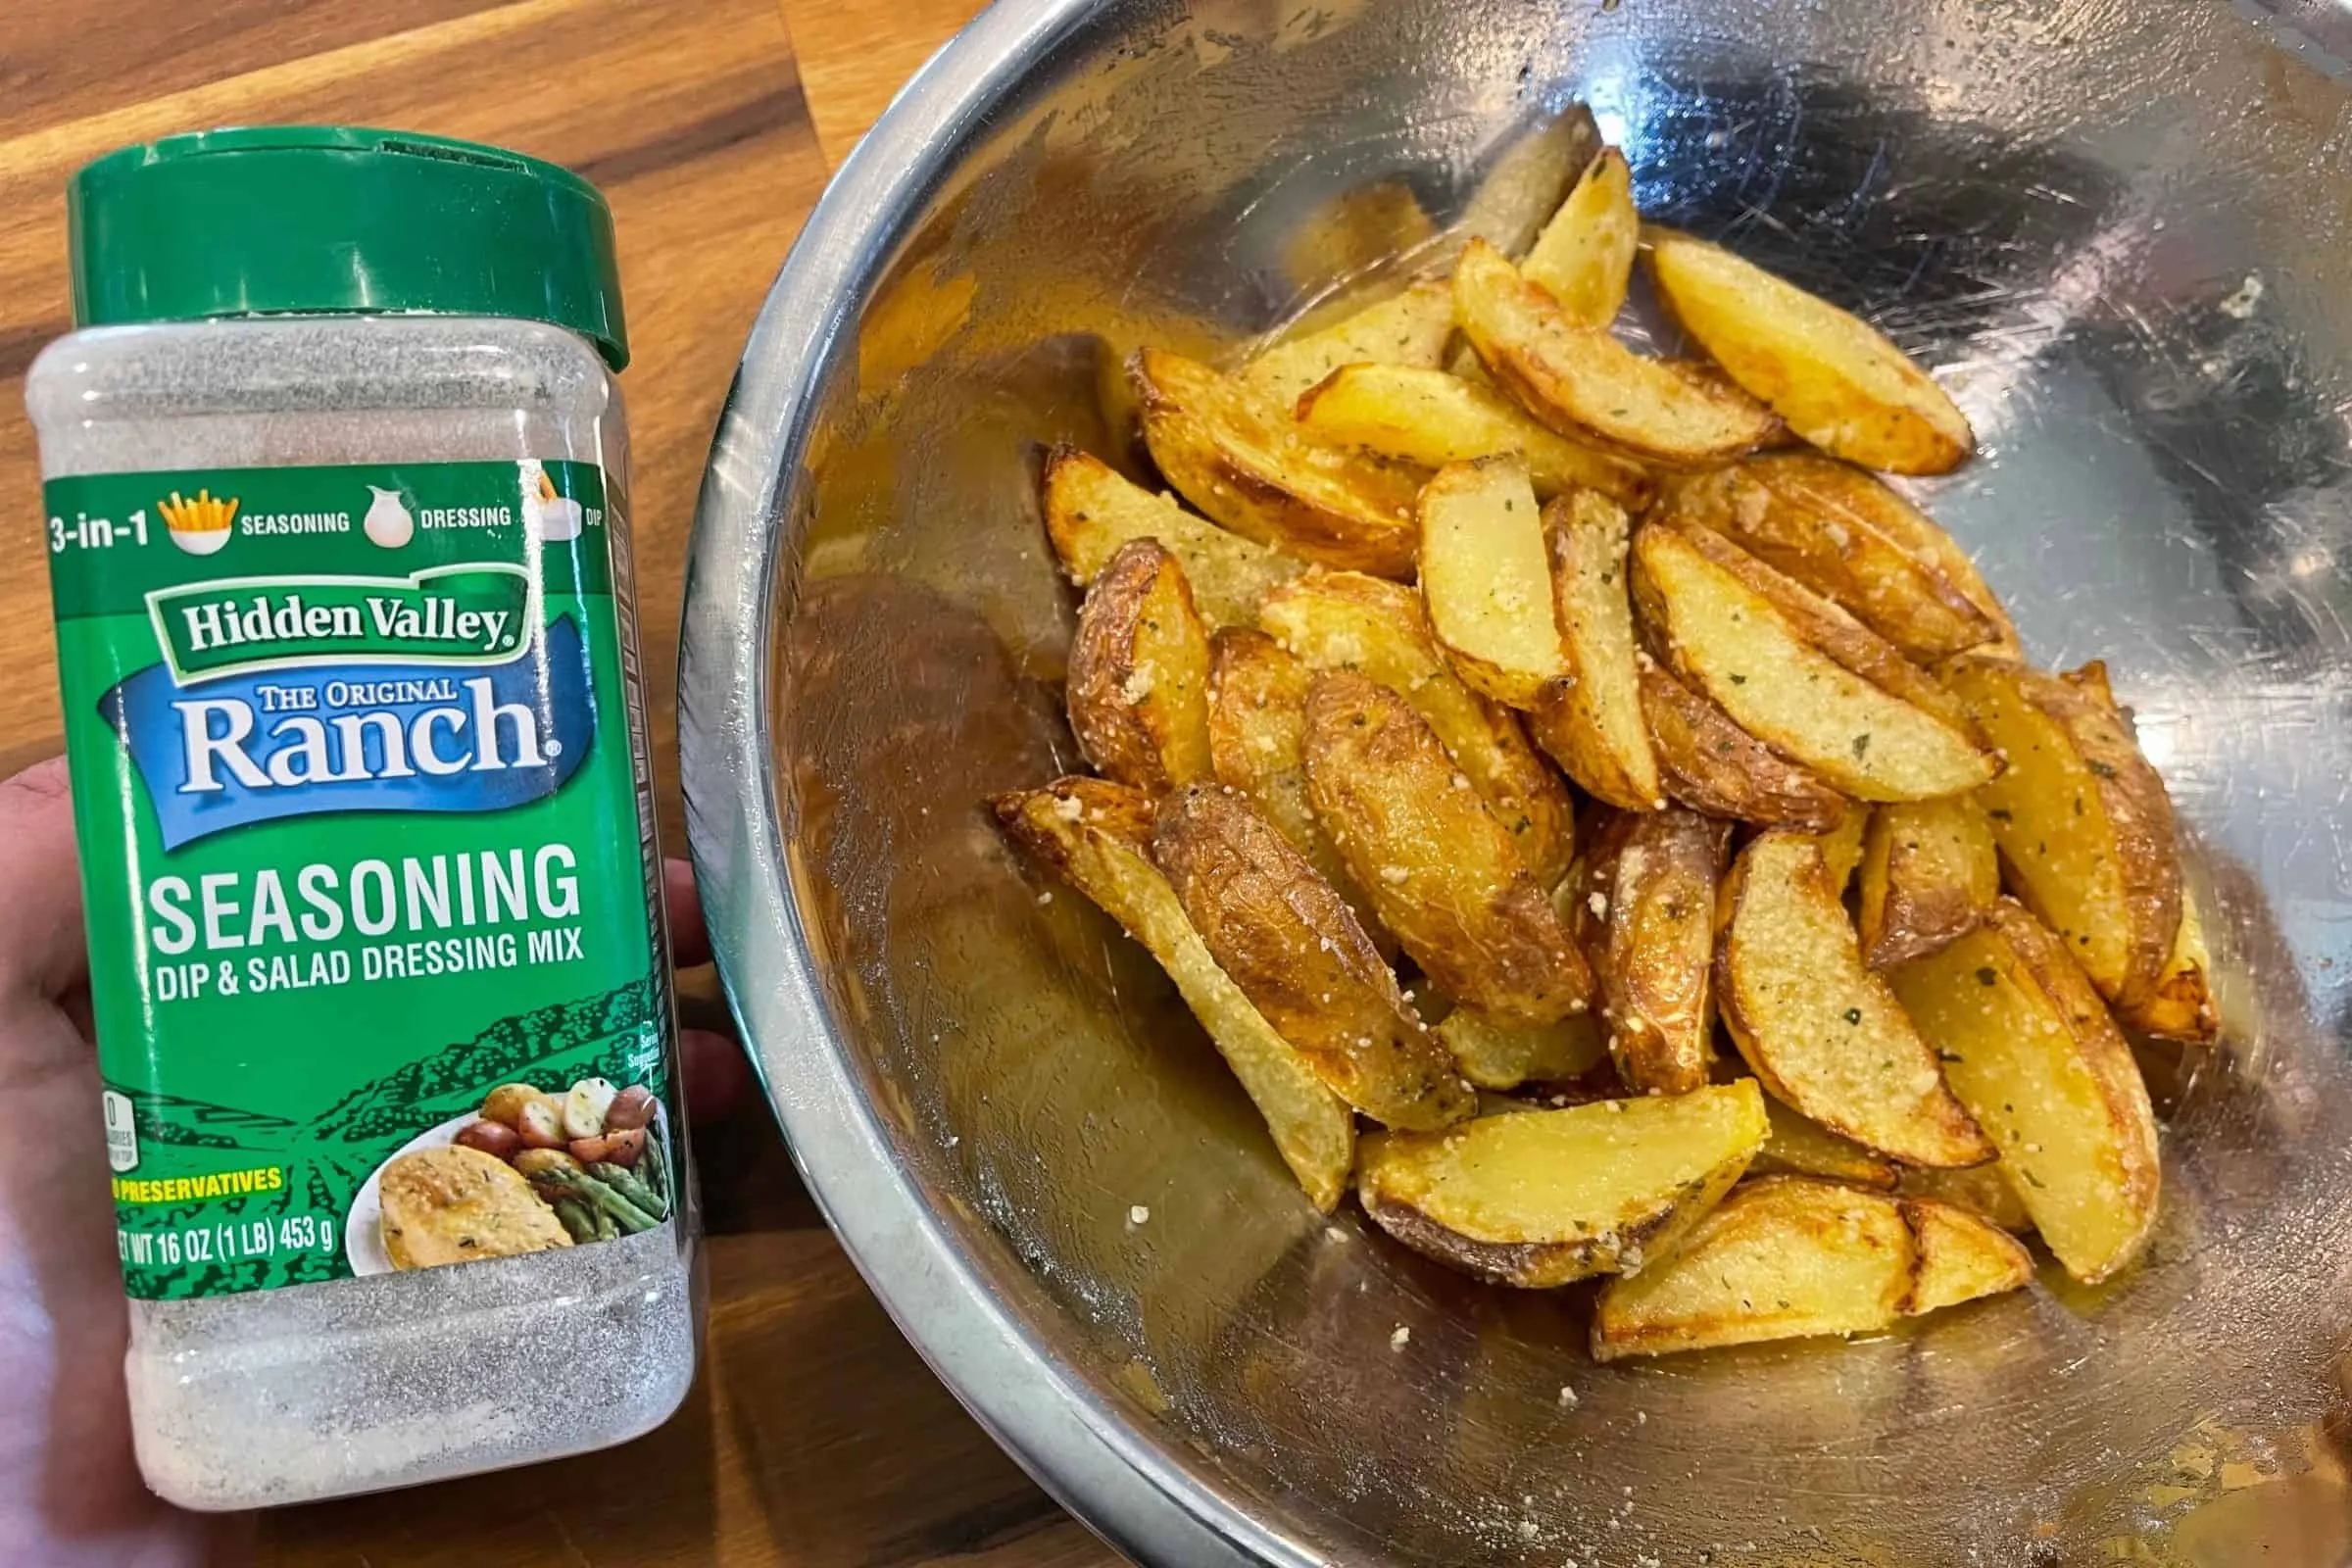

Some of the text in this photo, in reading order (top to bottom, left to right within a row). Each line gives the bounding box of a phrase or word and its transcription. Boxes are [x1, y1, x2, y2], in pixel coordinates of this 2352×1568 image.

[49, 509, 148, 553] 3-in-1
[240, 513, 351, 536] SEASONING
[420, 507, 512, 529] DRESSING
[585, 507, 603, 527] DIP
[181, 595, 363, 652] Hidden
[257, 678, 458, 711] THE ORIGINAL
[148, 843, 581, 956] SEASONING
[156, 926, 585, 1003] DIP & SALAD DRESSING MIX
[121, 1167, 282, 1202] PRESERVATIVES
[130, 1232, 153, 1265] WT
[157, 1232, 181, 1265] 16
[184, 1228, 214, 1263] OZ
[217, 1222, 236, 1262] (1
[241, 1216, 275, 1256] LB)
[279, 1215, 316, 1250] 453
[320, 1219, 332, 1252] g
